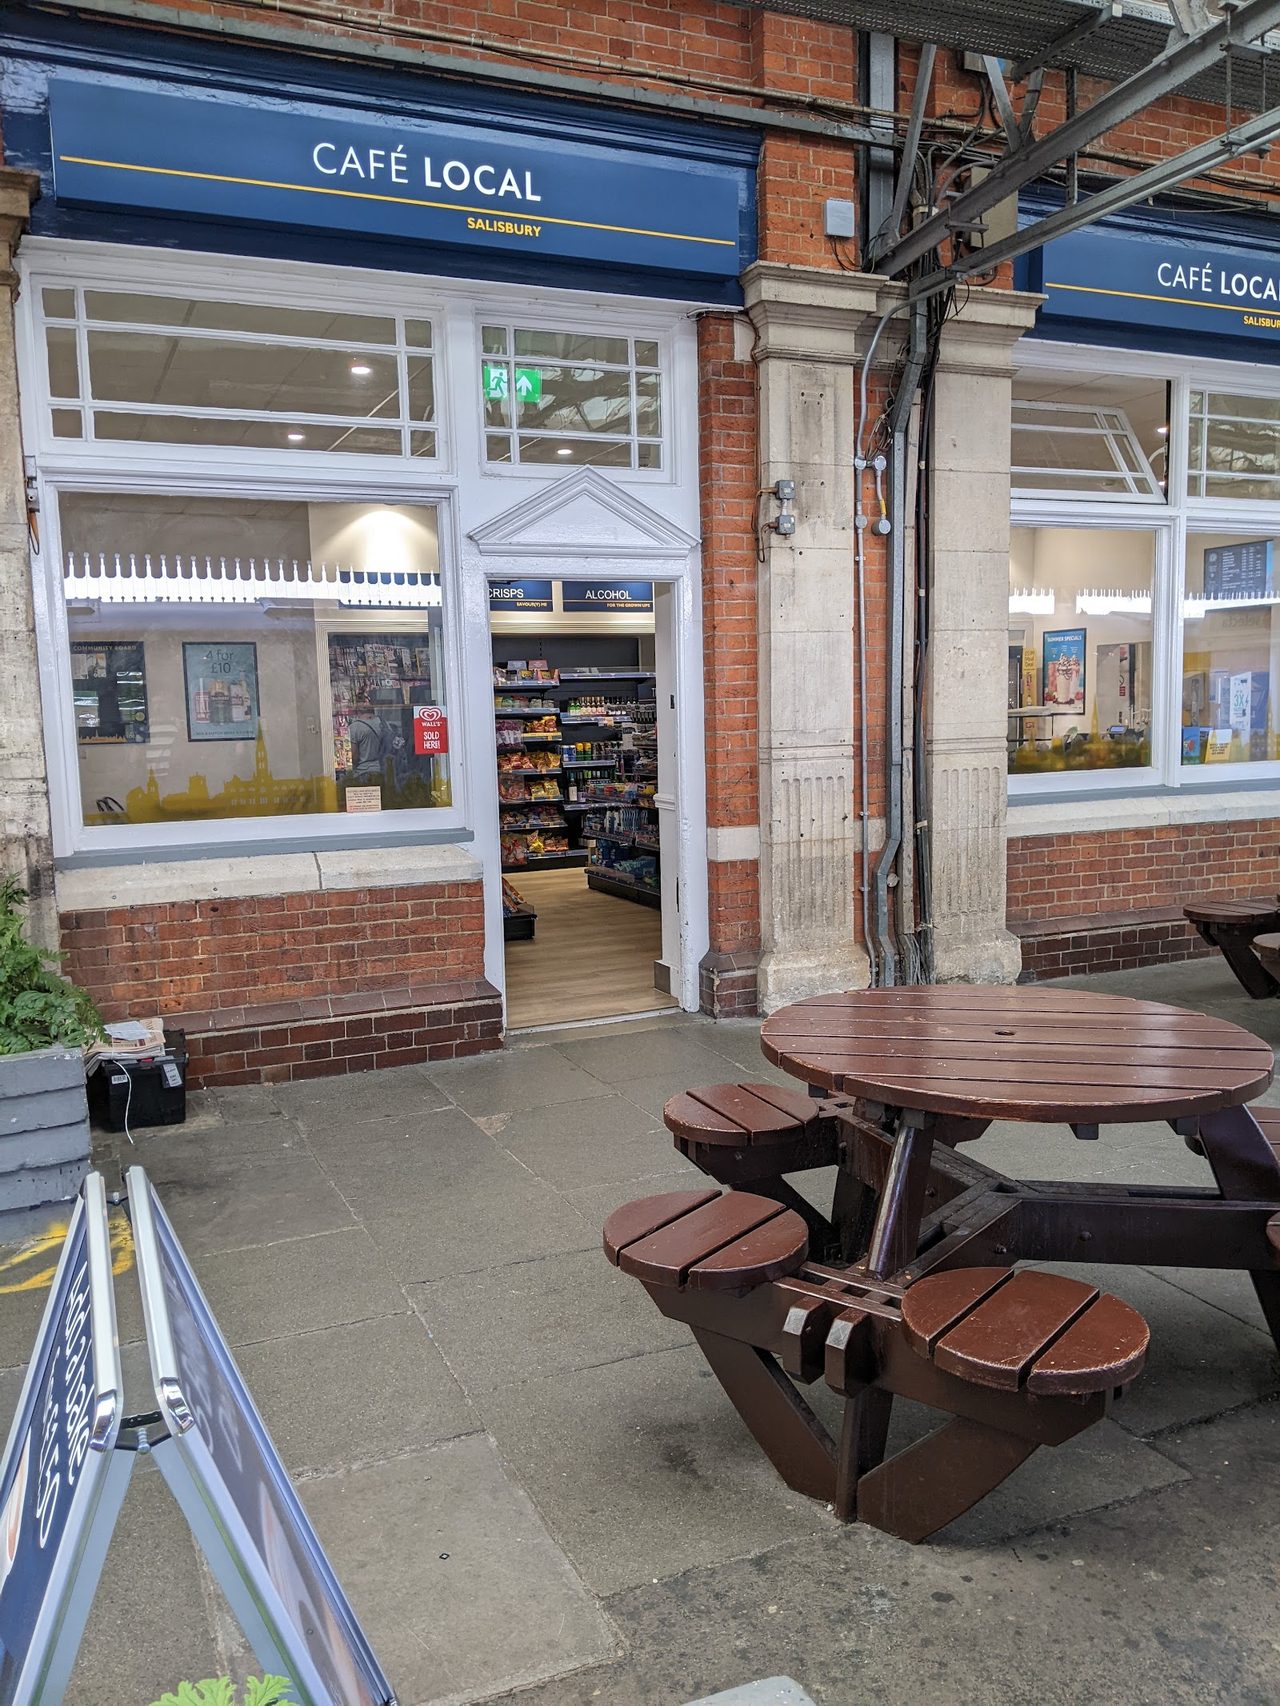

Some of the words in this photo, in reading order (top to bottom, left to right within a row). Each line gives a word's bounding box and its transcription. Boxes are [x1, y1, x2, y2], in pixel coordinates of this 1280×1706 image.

[312, 142, 409, 184] CAFÉ
[424, 156, 542, 202] LOCAL
[467, 217, 542, 238] SALISBURY
[1157, 262, 1213, 292] CAFÉ
[1220, 271, 1280, 302] LOCA
[488, 588, 524, 599] CRISPS
[585, 590, 632, 600] ALCOHOL
[206, 650, 214, 660] 4
[216, 649, 234, 660] for
[211, 662, 232, 674] £10
[424, 732, 440, 740] SOLD
[66, 1260, 90, 1359] Add
[66, 1337, 94, 1485] bake
